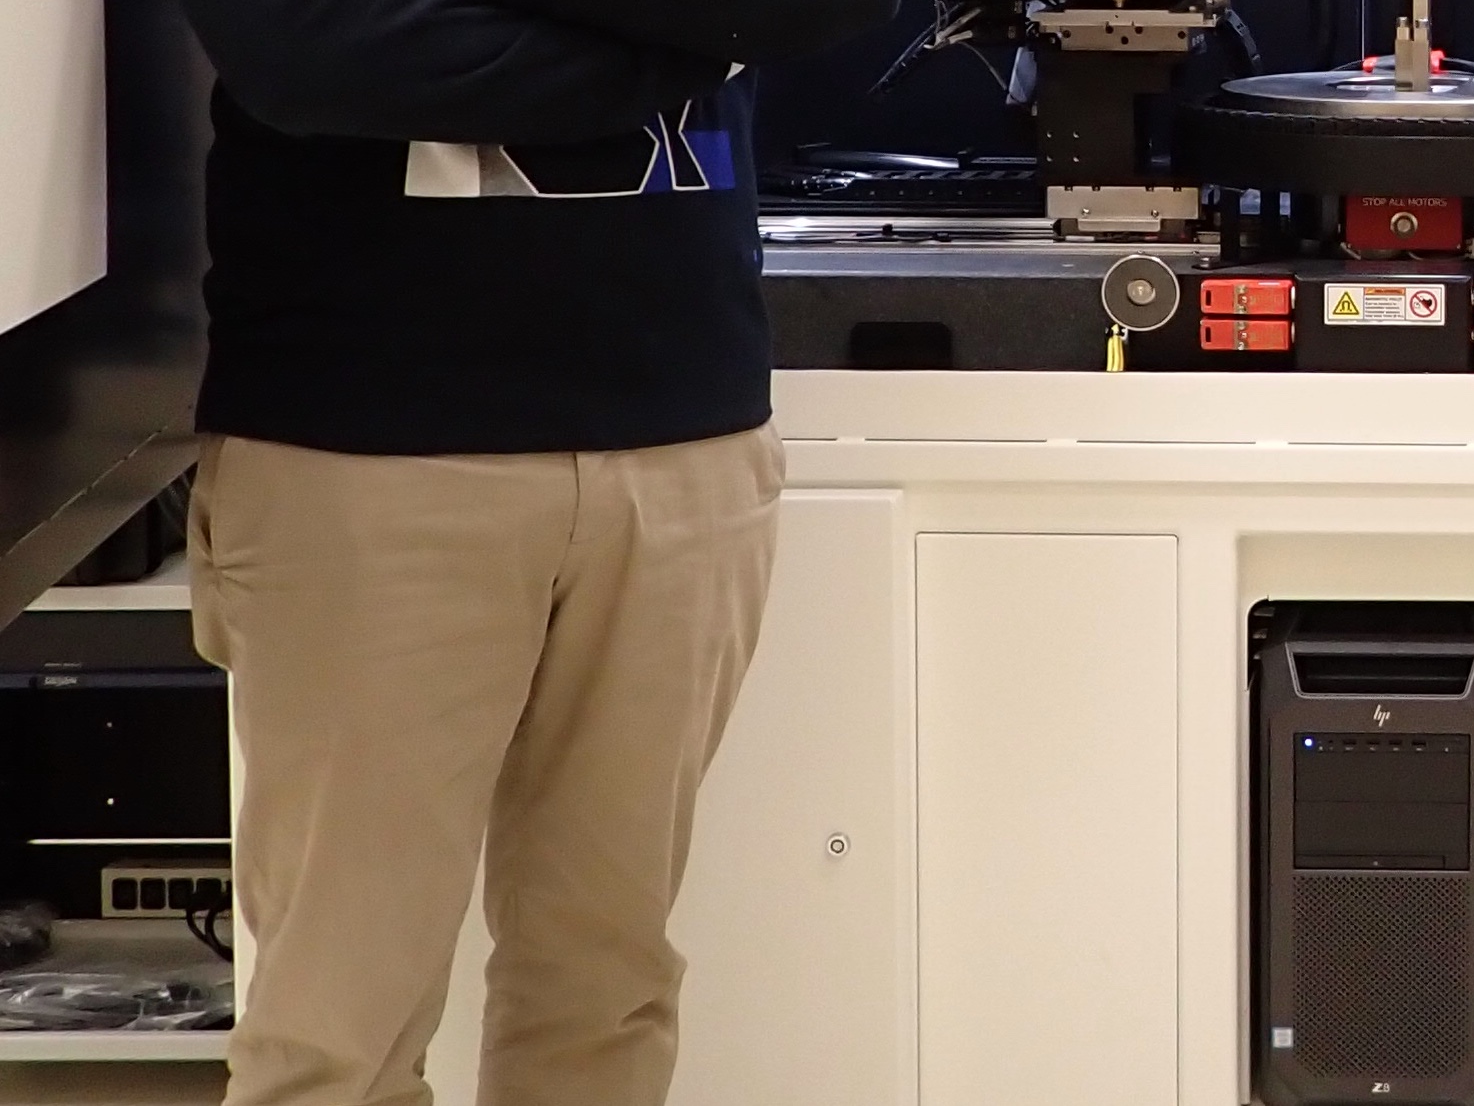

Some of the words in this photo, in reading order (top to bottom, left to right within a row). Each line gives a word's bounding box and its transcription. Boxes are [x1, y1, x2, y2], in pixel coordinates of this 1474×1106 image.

[1362, 197, 1387, 207] STOP
[1388, 197, 1406, 207] ALL
[1408, 197, 1448, 207] MOTORS
[1373, 704, 1391, 727] hp
